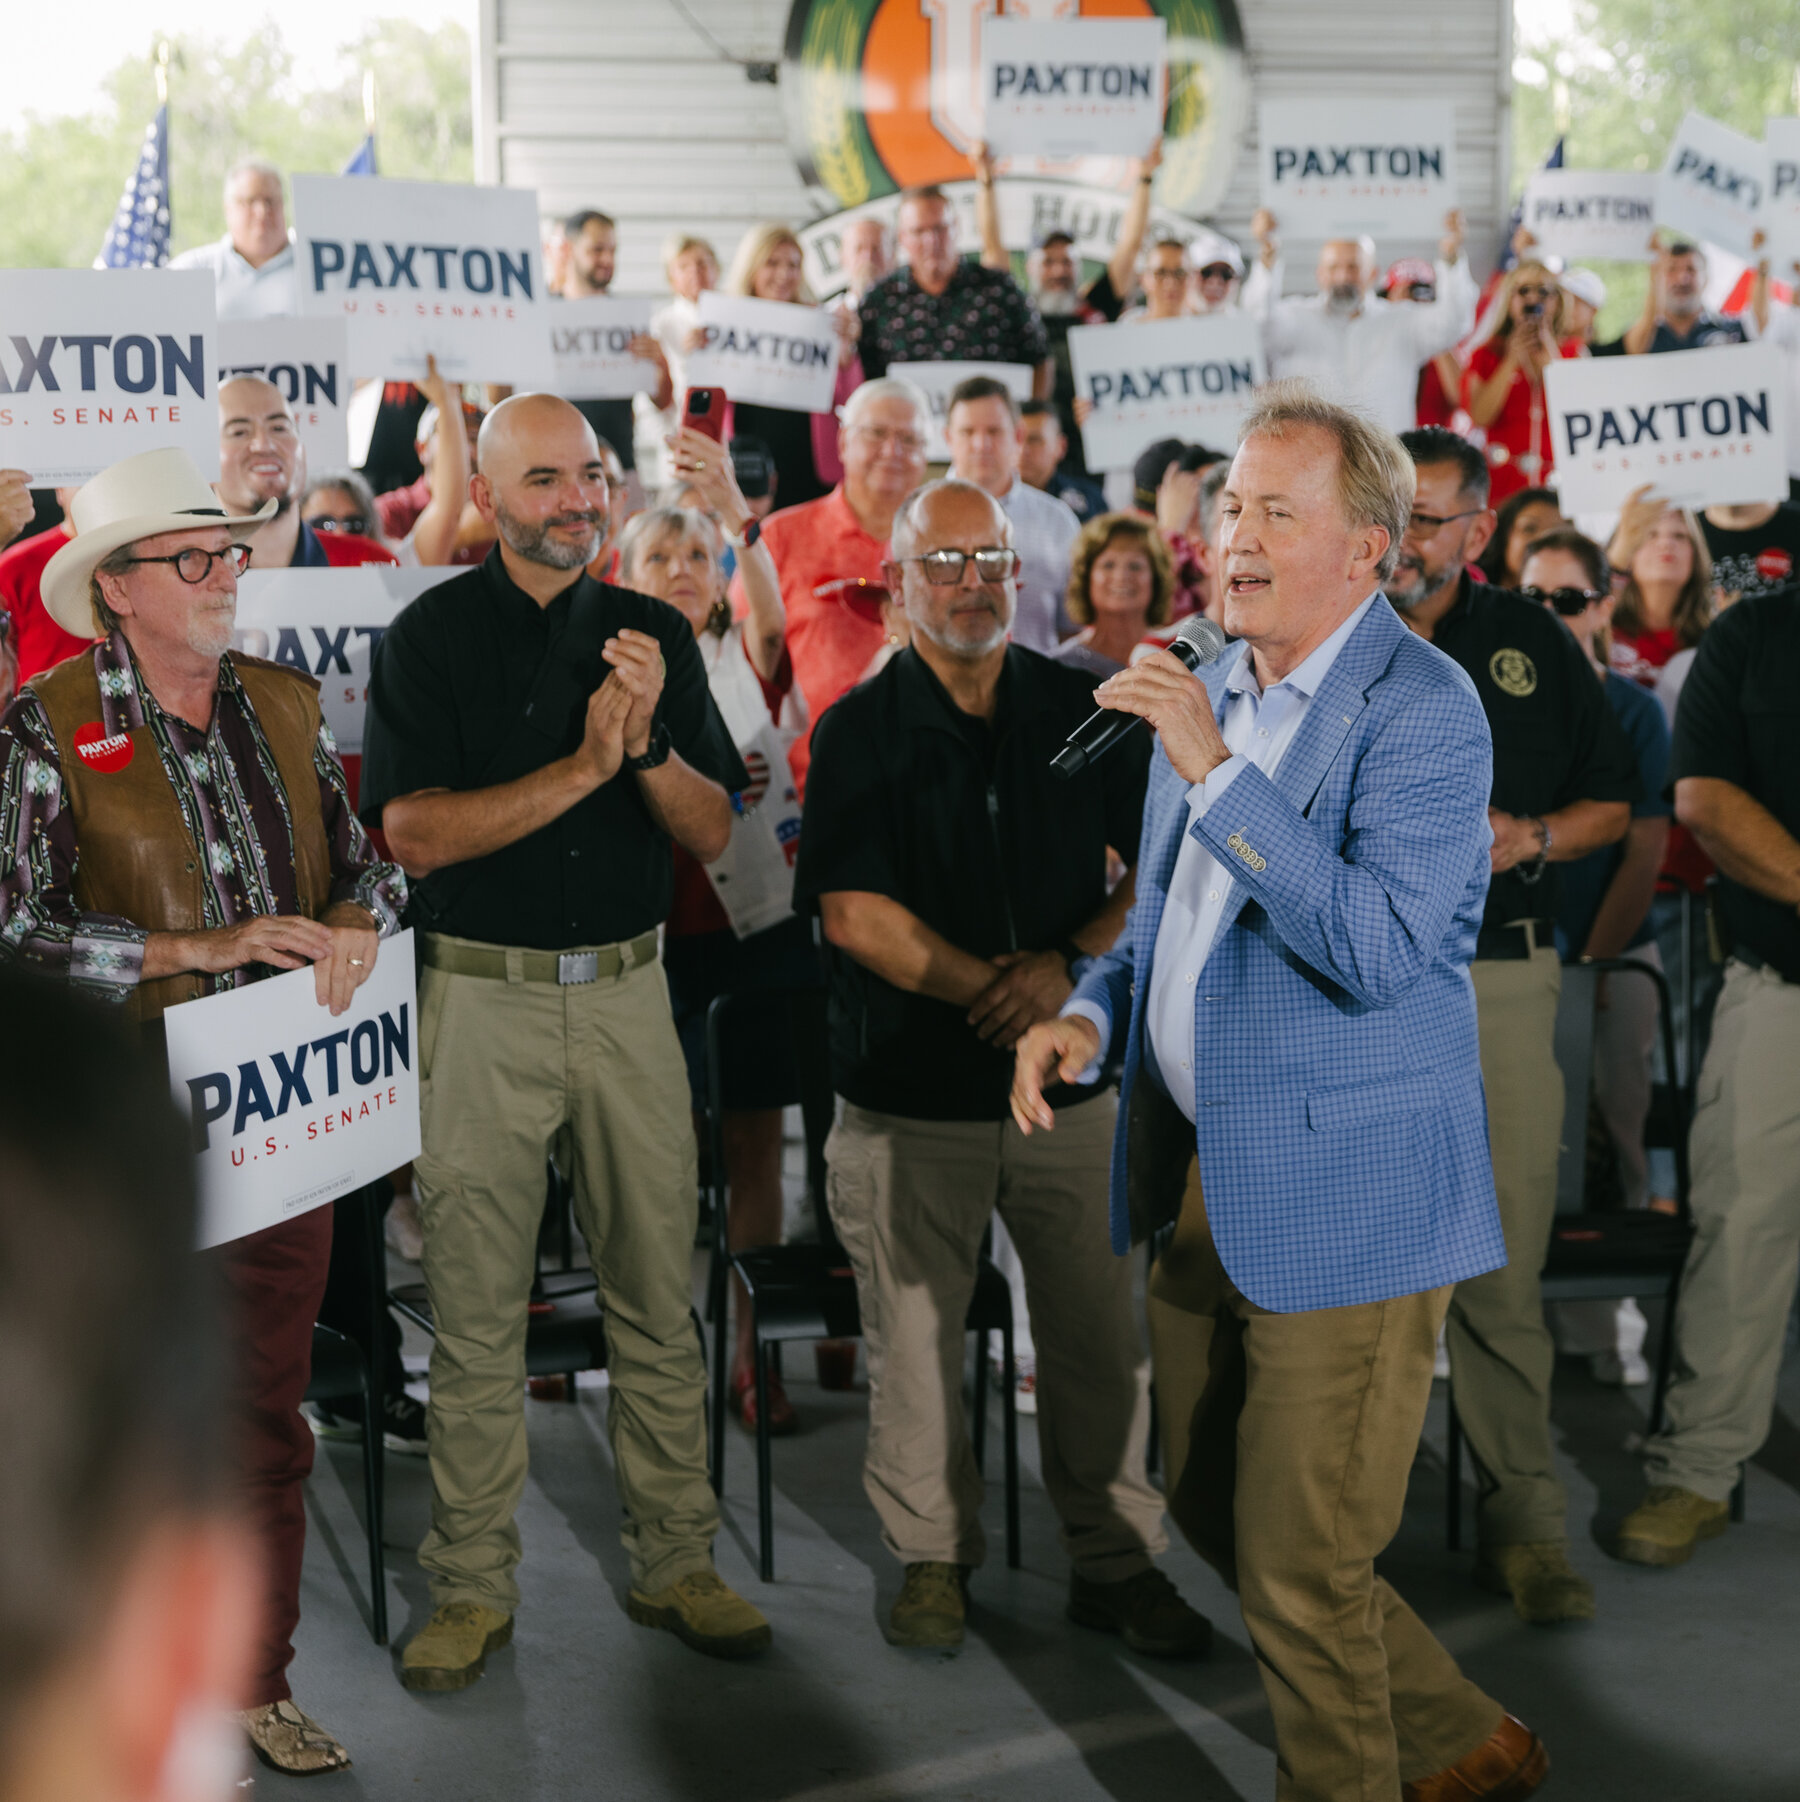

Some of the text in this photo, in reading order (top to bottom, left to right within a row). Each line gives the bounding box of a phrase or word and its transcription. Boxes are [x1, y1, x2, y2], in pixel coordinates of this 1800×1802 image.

[994, 63, 1151, 98] PAXTON
[1274, 145, 1442, 182] PAXTON
[309, 240, 534, 301] PAXTON
[0, 334, 205, 400] XTON
[704, 327, 832, 369] PAXTON
[1090, 360, 1253, 409] PAXTON
[53, 406, 181, 425] SENATE
[1564, 391, 1769, 456] PAXTON
[78, 732, 129, 758] PAXTON
[186, 1002, 411, 1154] PAXTON
[231, 1086, 397, 1167] U.S. SENATE
